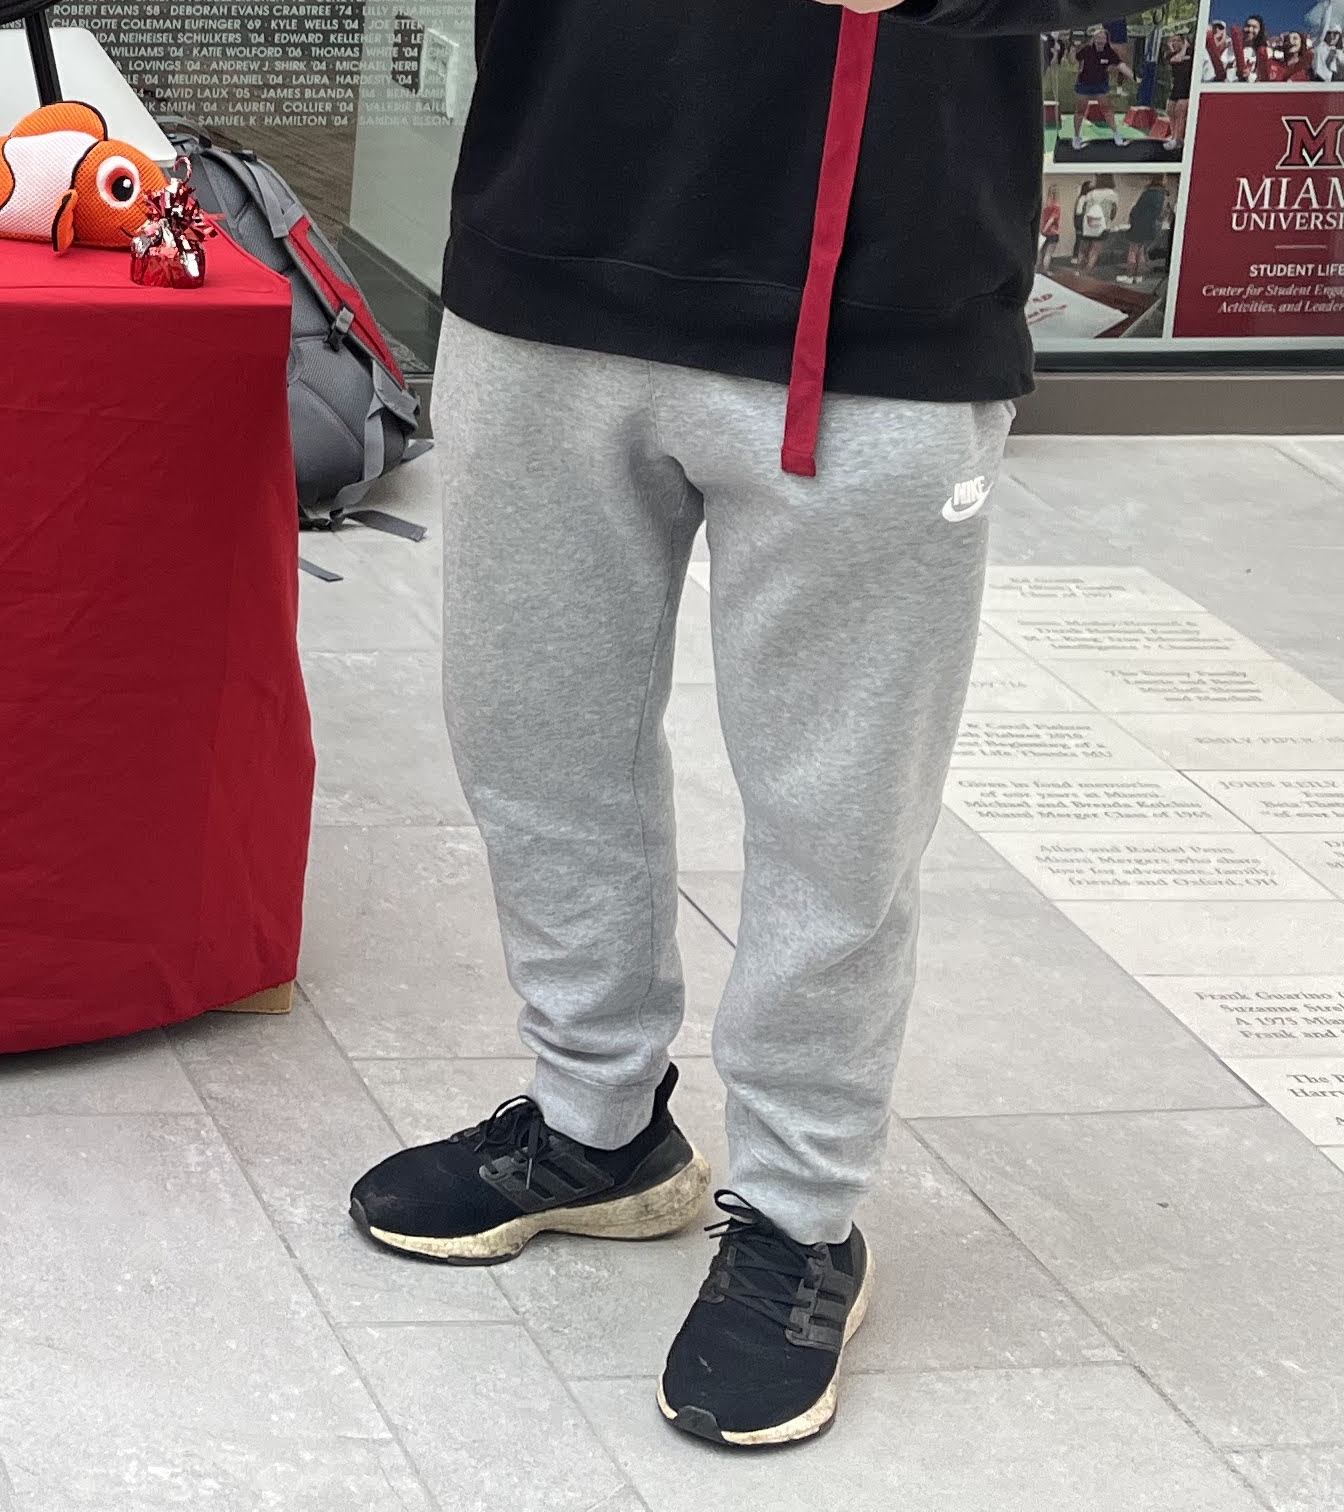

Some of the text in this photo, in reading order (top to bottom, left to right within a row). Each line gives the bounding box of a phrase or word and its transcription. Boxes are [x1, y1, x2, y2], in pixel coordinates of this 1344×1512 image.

[270, 18, 358, 29] KYLE WELLS '04
[1231, 212, 1344, 231] UNIVERSI
[1250, 264, 1344, 278] STUDENT LIFE
[1202, 284, 1242, 296] Center
[1242, 284, 1263, 298] for
[1266, 283, 1311, 296] Student
[1218, 300, 1344, 314] Activities, and Leader
[1255, 992, 1333, 1000] Guarino
[1220, 1004, 1300, 1012] Suzanne
